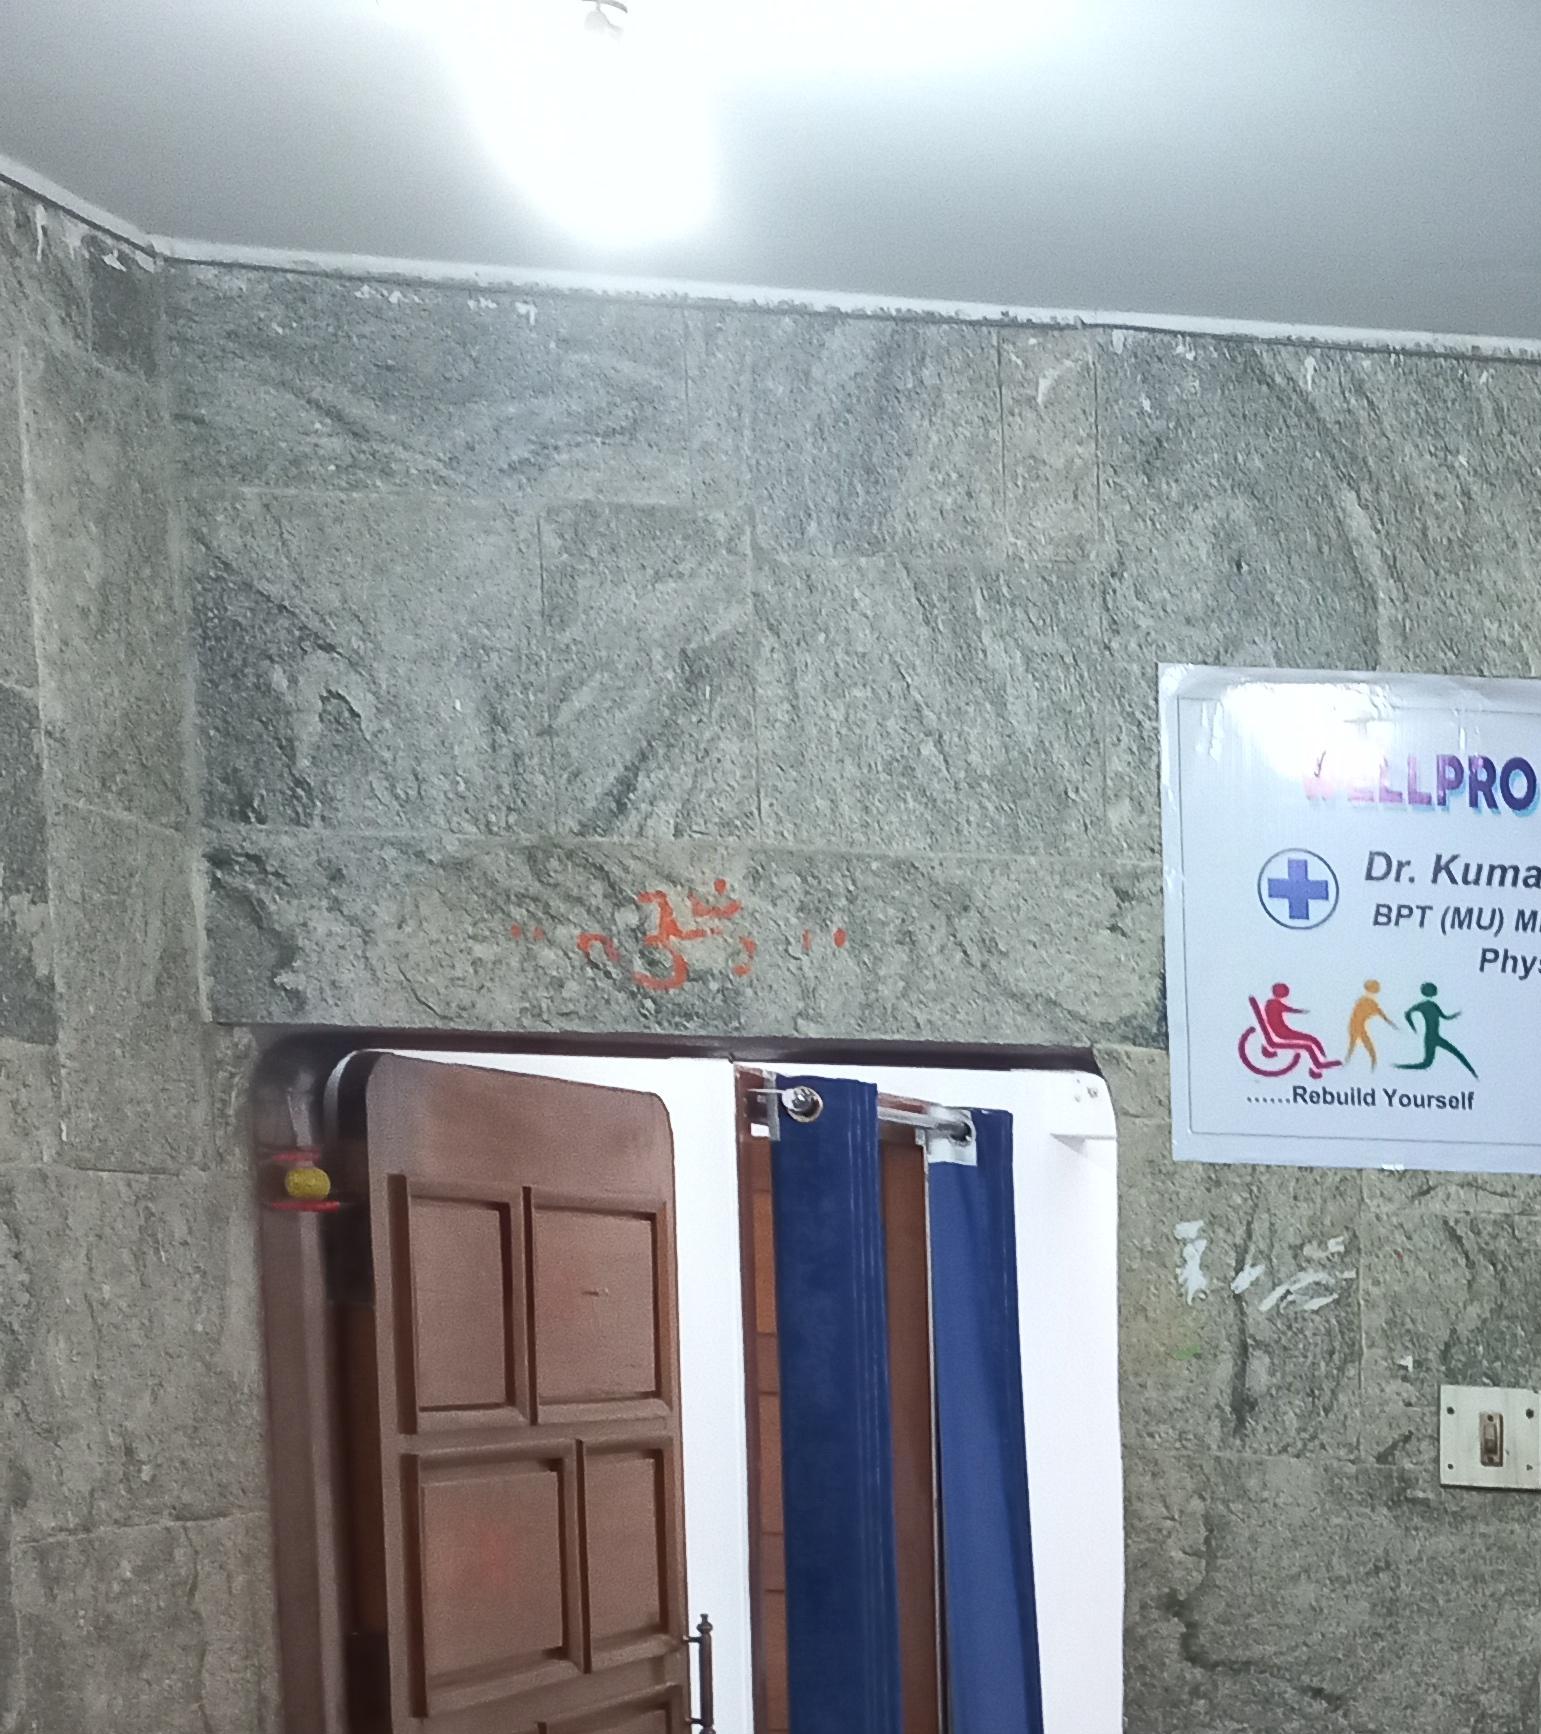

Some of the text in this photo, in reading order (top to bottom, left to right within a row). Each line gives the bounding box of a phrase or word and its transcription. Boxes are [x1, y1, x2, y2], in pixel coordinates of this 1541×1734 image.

[1302, 752, 1540, 814] LLPRO
[1365, 850, 1415, 884] Dr.
[1372, 903, 1434, 929] BPT
[1440, 906, 1504, 937] (MU)
[1382, 1088, 1475, 1110] Yourself
